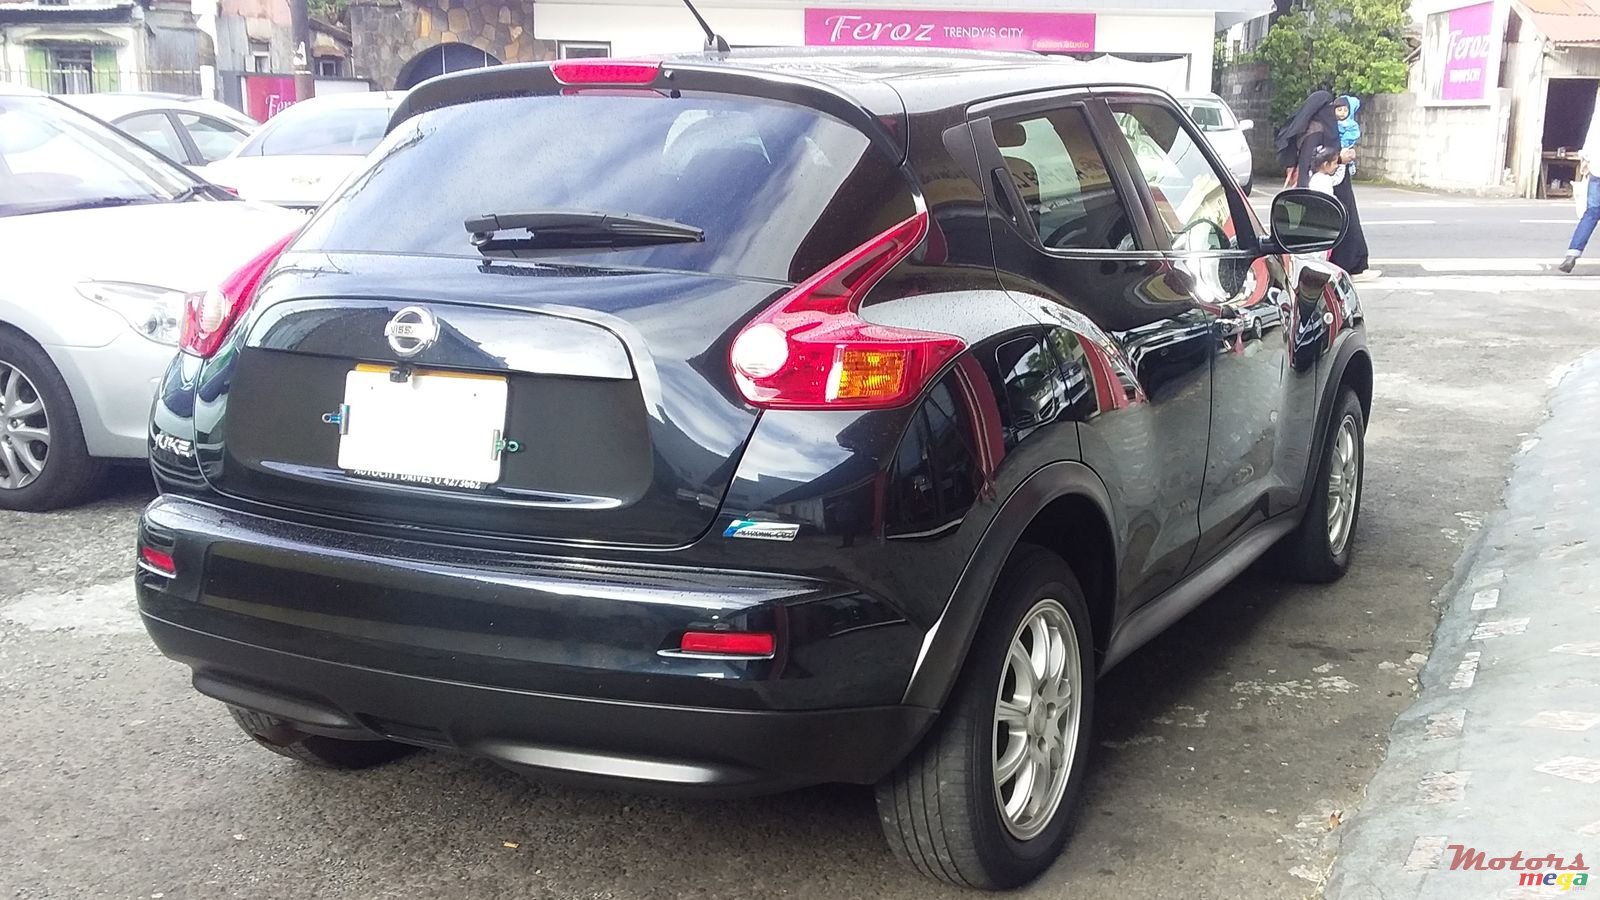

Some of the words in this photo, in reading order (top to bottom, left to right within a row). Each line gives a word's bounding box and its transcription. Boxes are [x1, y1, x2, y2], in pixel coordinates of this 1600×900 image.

[825, 15, 935, 42] Feroz
[943, 26, 996, 38] TRENDY'S
[998, 27, 1024, 38] CITY
[1063, 40, 1090, 49] Studio
[153, 433, 191, 457] JUKE
